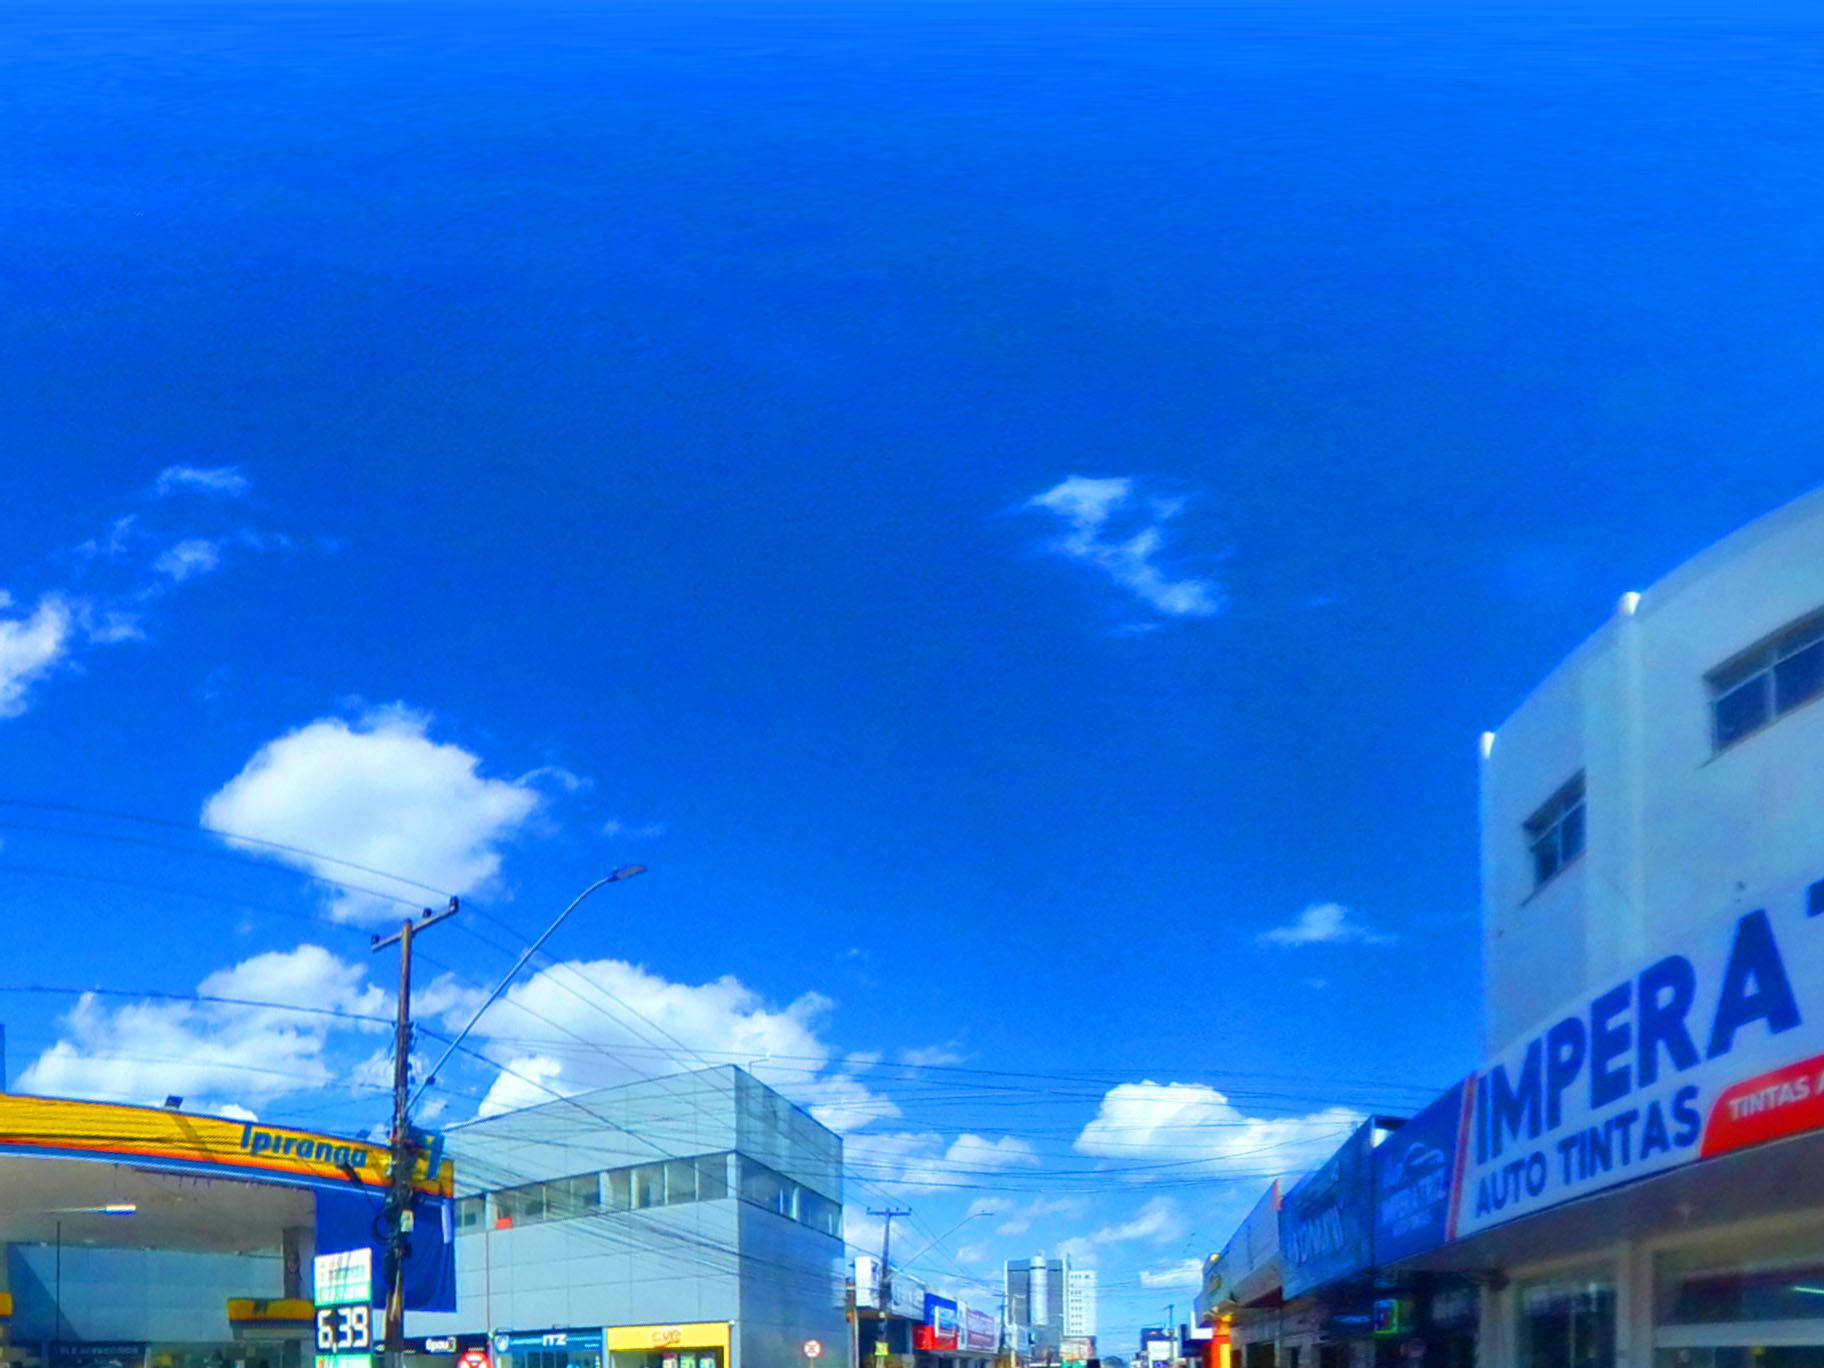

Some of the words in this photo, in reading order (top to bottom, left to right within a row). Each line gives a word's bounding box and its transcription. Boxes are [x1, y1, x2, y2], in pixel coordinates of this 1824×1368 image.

[1729, 1076, 1810, 1120] TINTAS
[240, 1124, 367, 1168] Ipiranga
[1475, 1151, 1547, 1218] AUTO
[1557, 1085, 1701, 1186] TINTAS
[317, 1304, 370, 1353] 6,39
